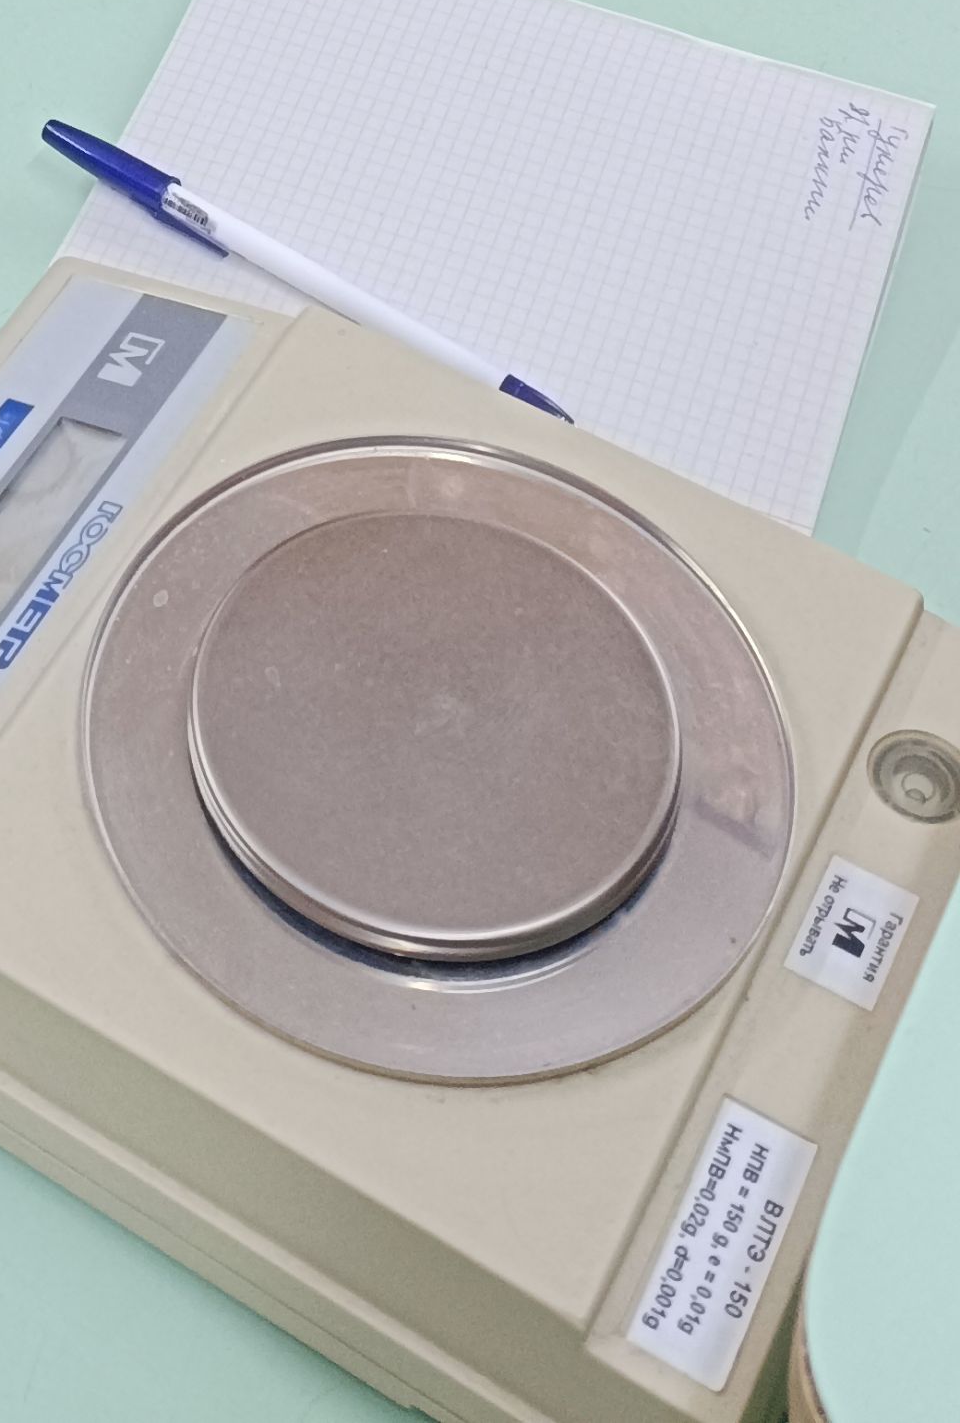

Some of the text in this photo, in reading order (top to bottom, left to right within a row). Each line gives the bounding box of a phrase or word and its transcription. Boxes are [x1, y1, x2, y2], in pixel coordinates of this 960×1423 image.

[799, 874, 848, 957] Не отрывать
[862, 911, 904, 983] Гарантия
[742, 1142, 769, 1184] НПВ
[723, 1203, 746, 1234] 150
[747, 1199, 784, 1262] ВЛТЭ
[641, 1245, 692, 1330] d=0,001g
[677, 1286, 712, 1335] 0,01g
[724, 1280, 753, 1319] 150
